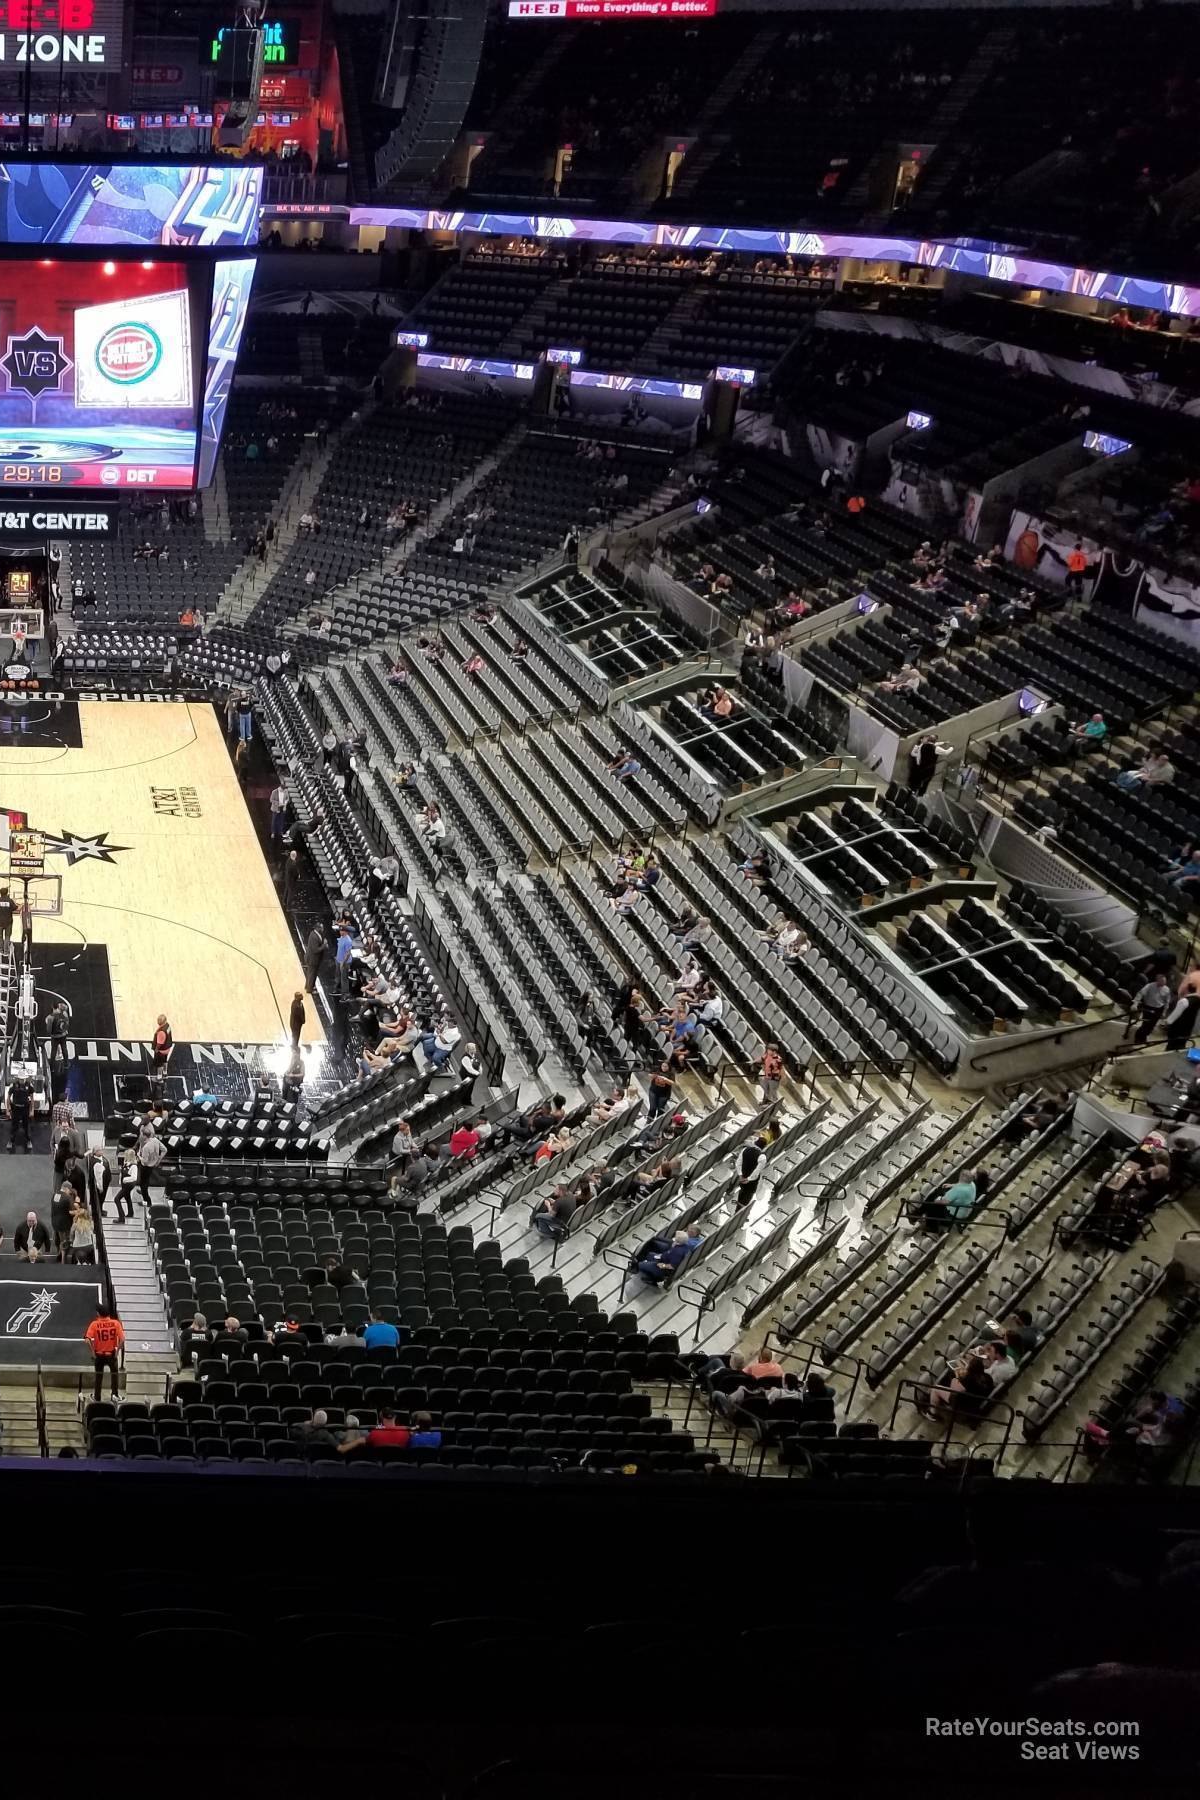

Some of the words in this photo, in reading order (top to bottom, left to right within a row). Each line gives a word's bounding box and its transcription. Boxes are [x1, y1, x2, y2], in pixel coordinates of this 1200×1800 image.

[576, 3, 600, 13] Here
[603, 2, 667, 13] Everything's
[671, 1, 708, 12] Better.
[16, 34, 106, 62] ZONE
[14, 351, 58, 377] VS
[3, 465, 62, 482] 29:18
[126, 468, 157, 483] DET
[32, 513, 109, 531] CENTER
[79, 692, 185, 703] SPURS
[150, 786, 182, 817] AT&T
[180, 786, 203, 818] CENTER
[97, 1328, 117, 1342] 169
